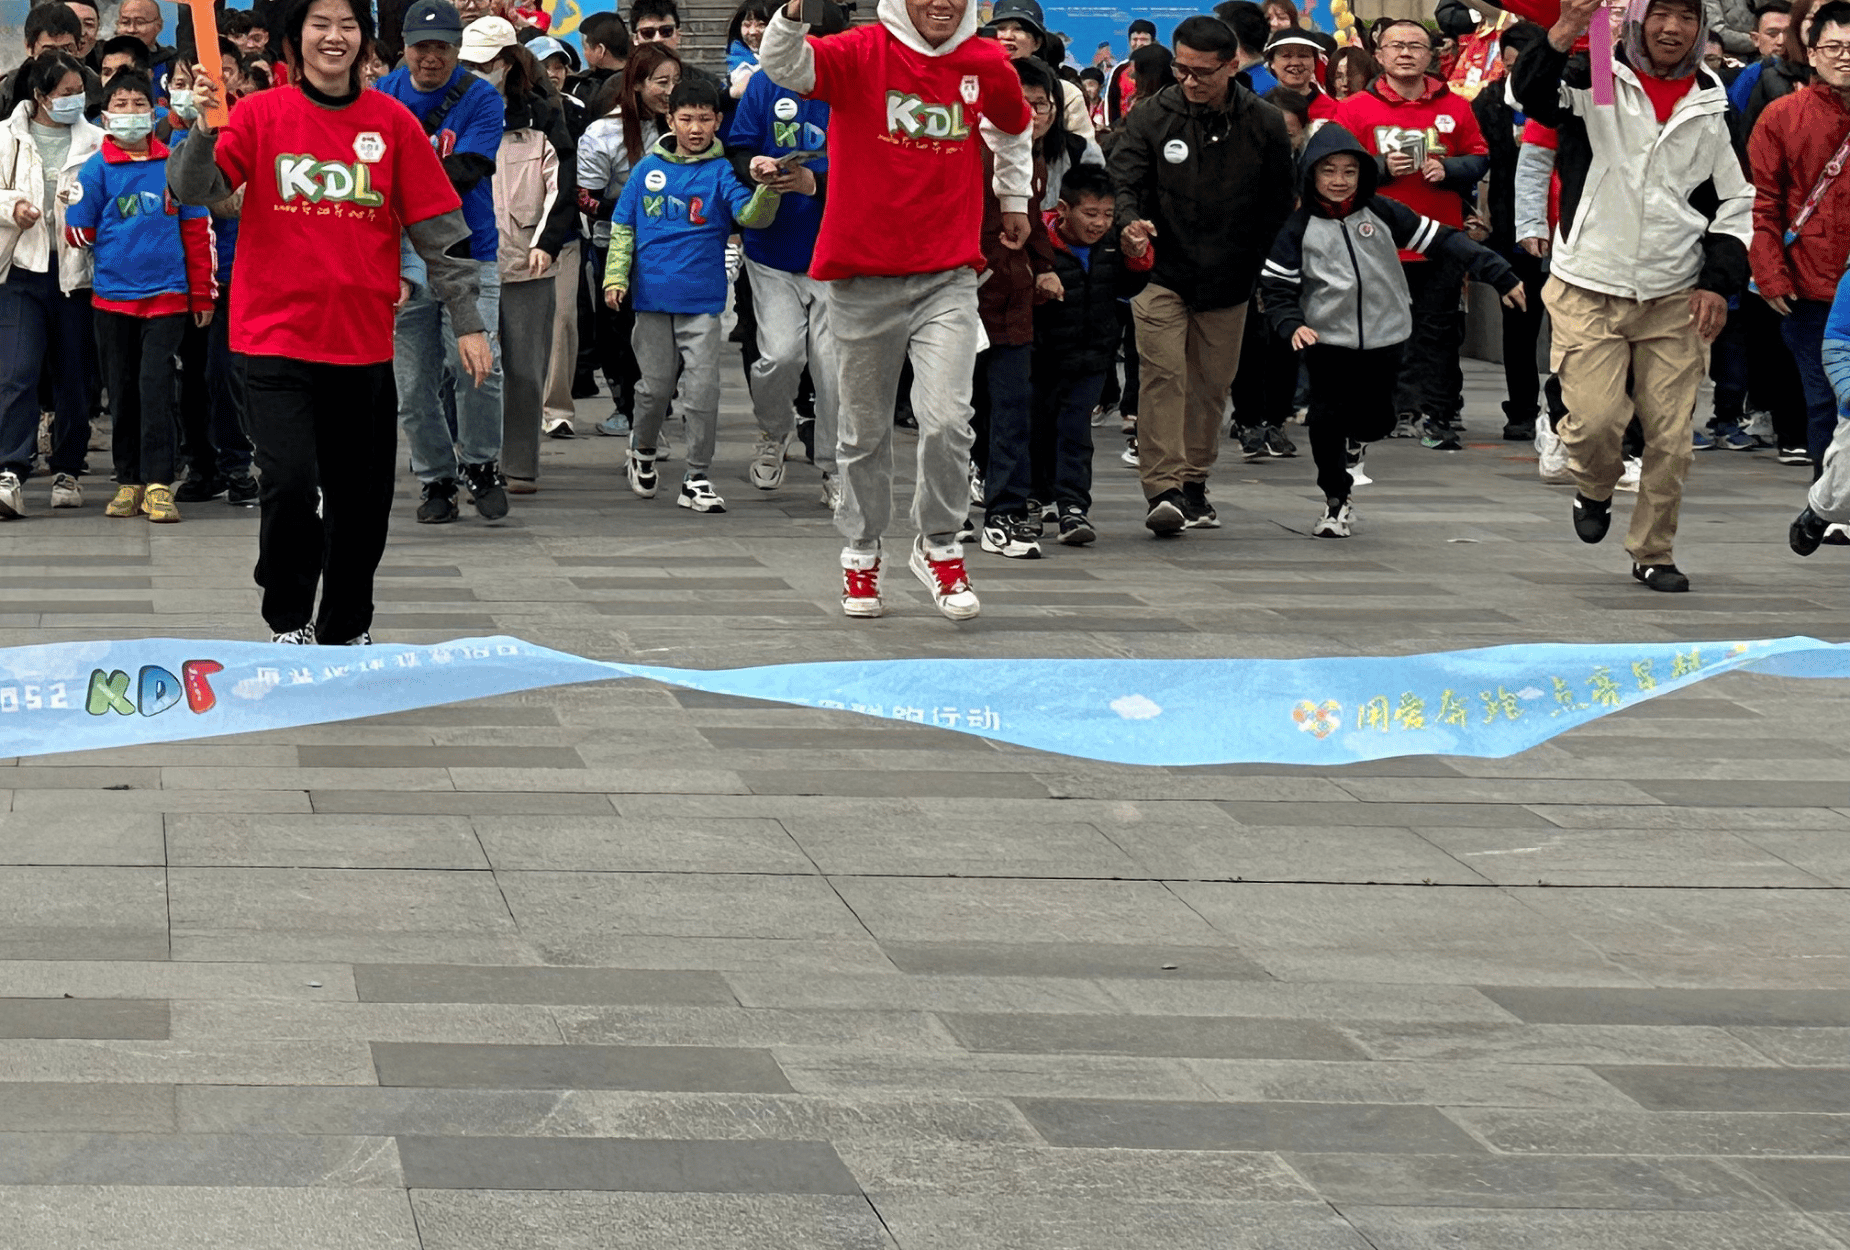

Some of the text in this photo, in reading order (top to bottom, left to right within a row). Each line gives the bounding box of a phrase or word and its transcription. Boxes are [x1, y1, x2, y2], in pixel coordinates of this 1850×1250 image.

[885, 89, 972, 138] KDL
[773, 121, 826, 150] KD
[275, 153, 384, 208] KDL
[643, 195, 707, 225] KDL
